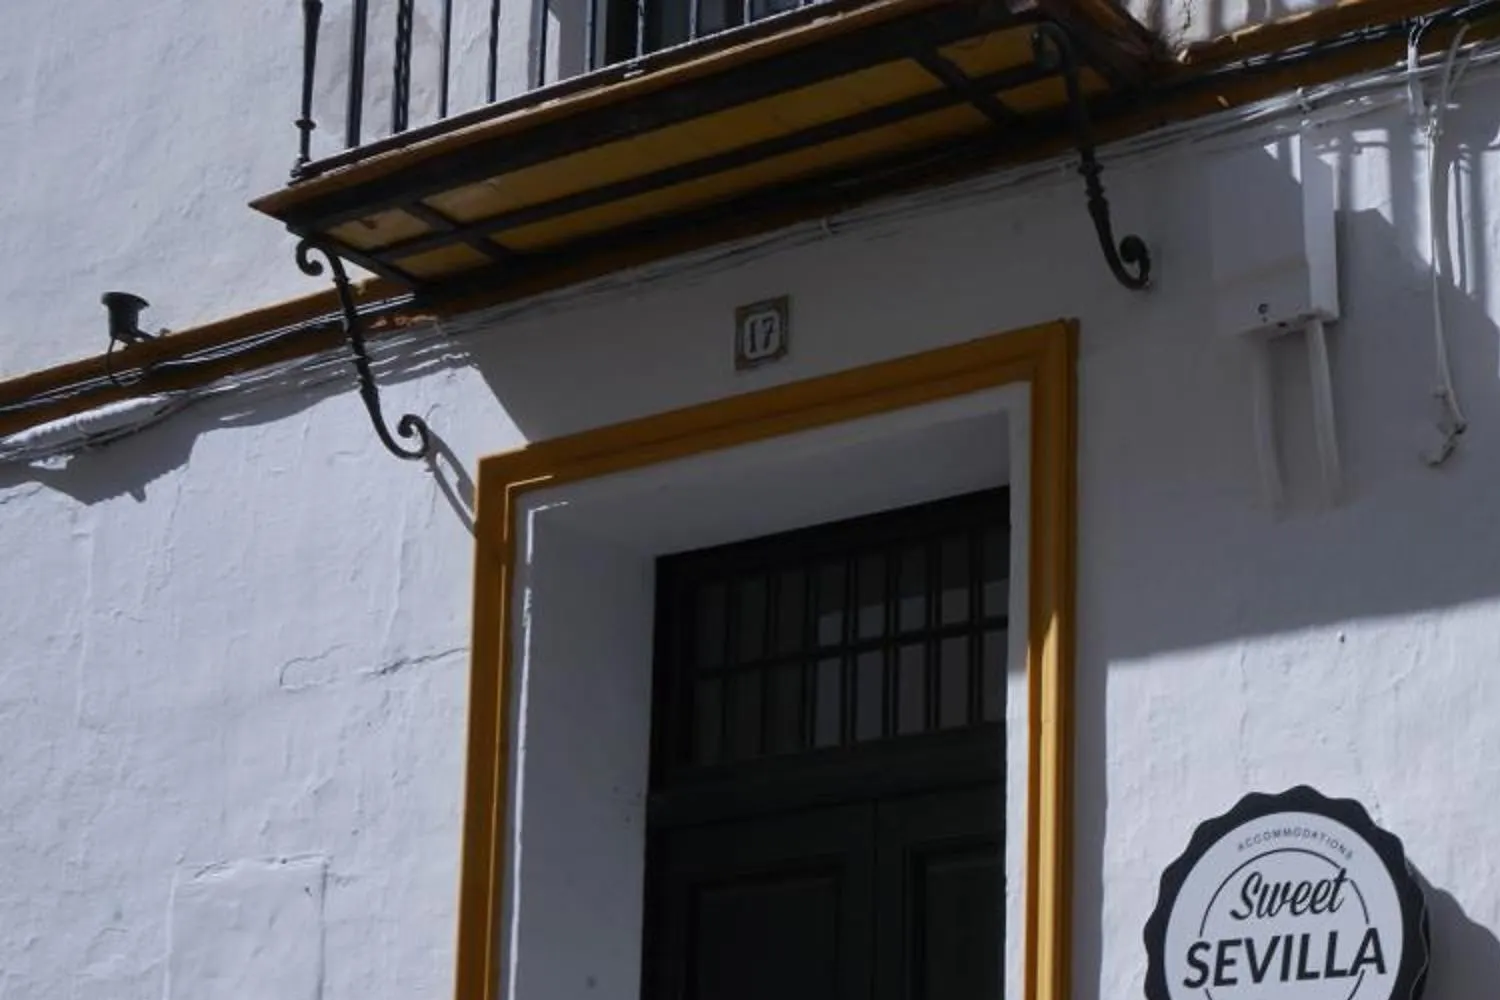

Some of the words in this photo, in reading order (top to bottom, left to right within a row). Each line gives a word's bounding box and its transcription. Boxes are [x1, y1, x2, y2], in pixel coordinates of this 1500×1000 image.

[748, 315, 776, 353] 17
[1230, 867, 1349, 921] Sweet
[1182, 927, 1388, 989] SEVILLA
